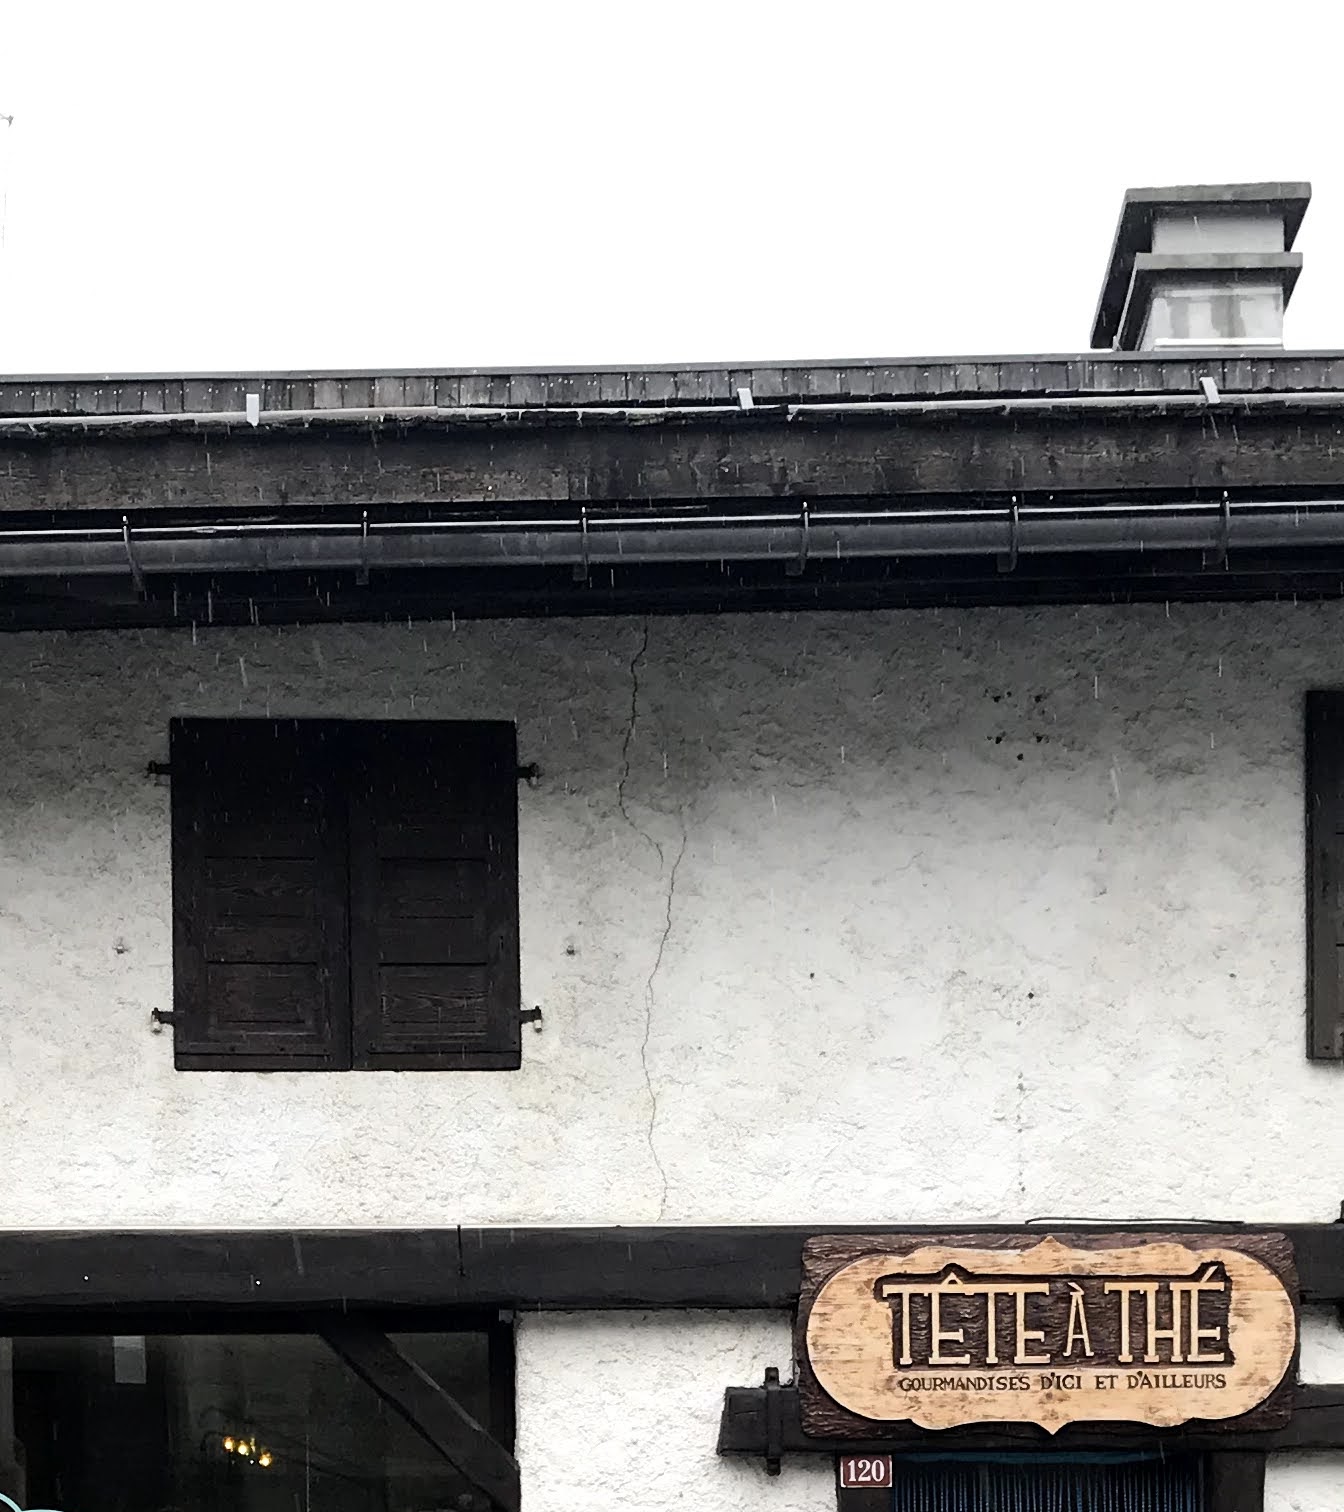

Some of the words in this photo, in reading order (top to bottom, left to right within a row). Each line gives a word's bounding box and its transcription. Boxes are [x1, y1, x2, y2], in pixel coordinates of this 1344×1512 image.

[882, 1272, 1051, 1366] TÊTE
[1062, 1281, 1095, 1358] À
[1104, 1265, 1226, 1364] THÉ
[899, 1375, 1031, 1391] GOURMANDISES
[1041, 1371, 1082, 1390] D'ICI
[1094, 1374, 1119, 1390] ET
[1127, 1370, 1227, 1389] D'AILLEURS
[847, 1459, 885, 1482] 120
